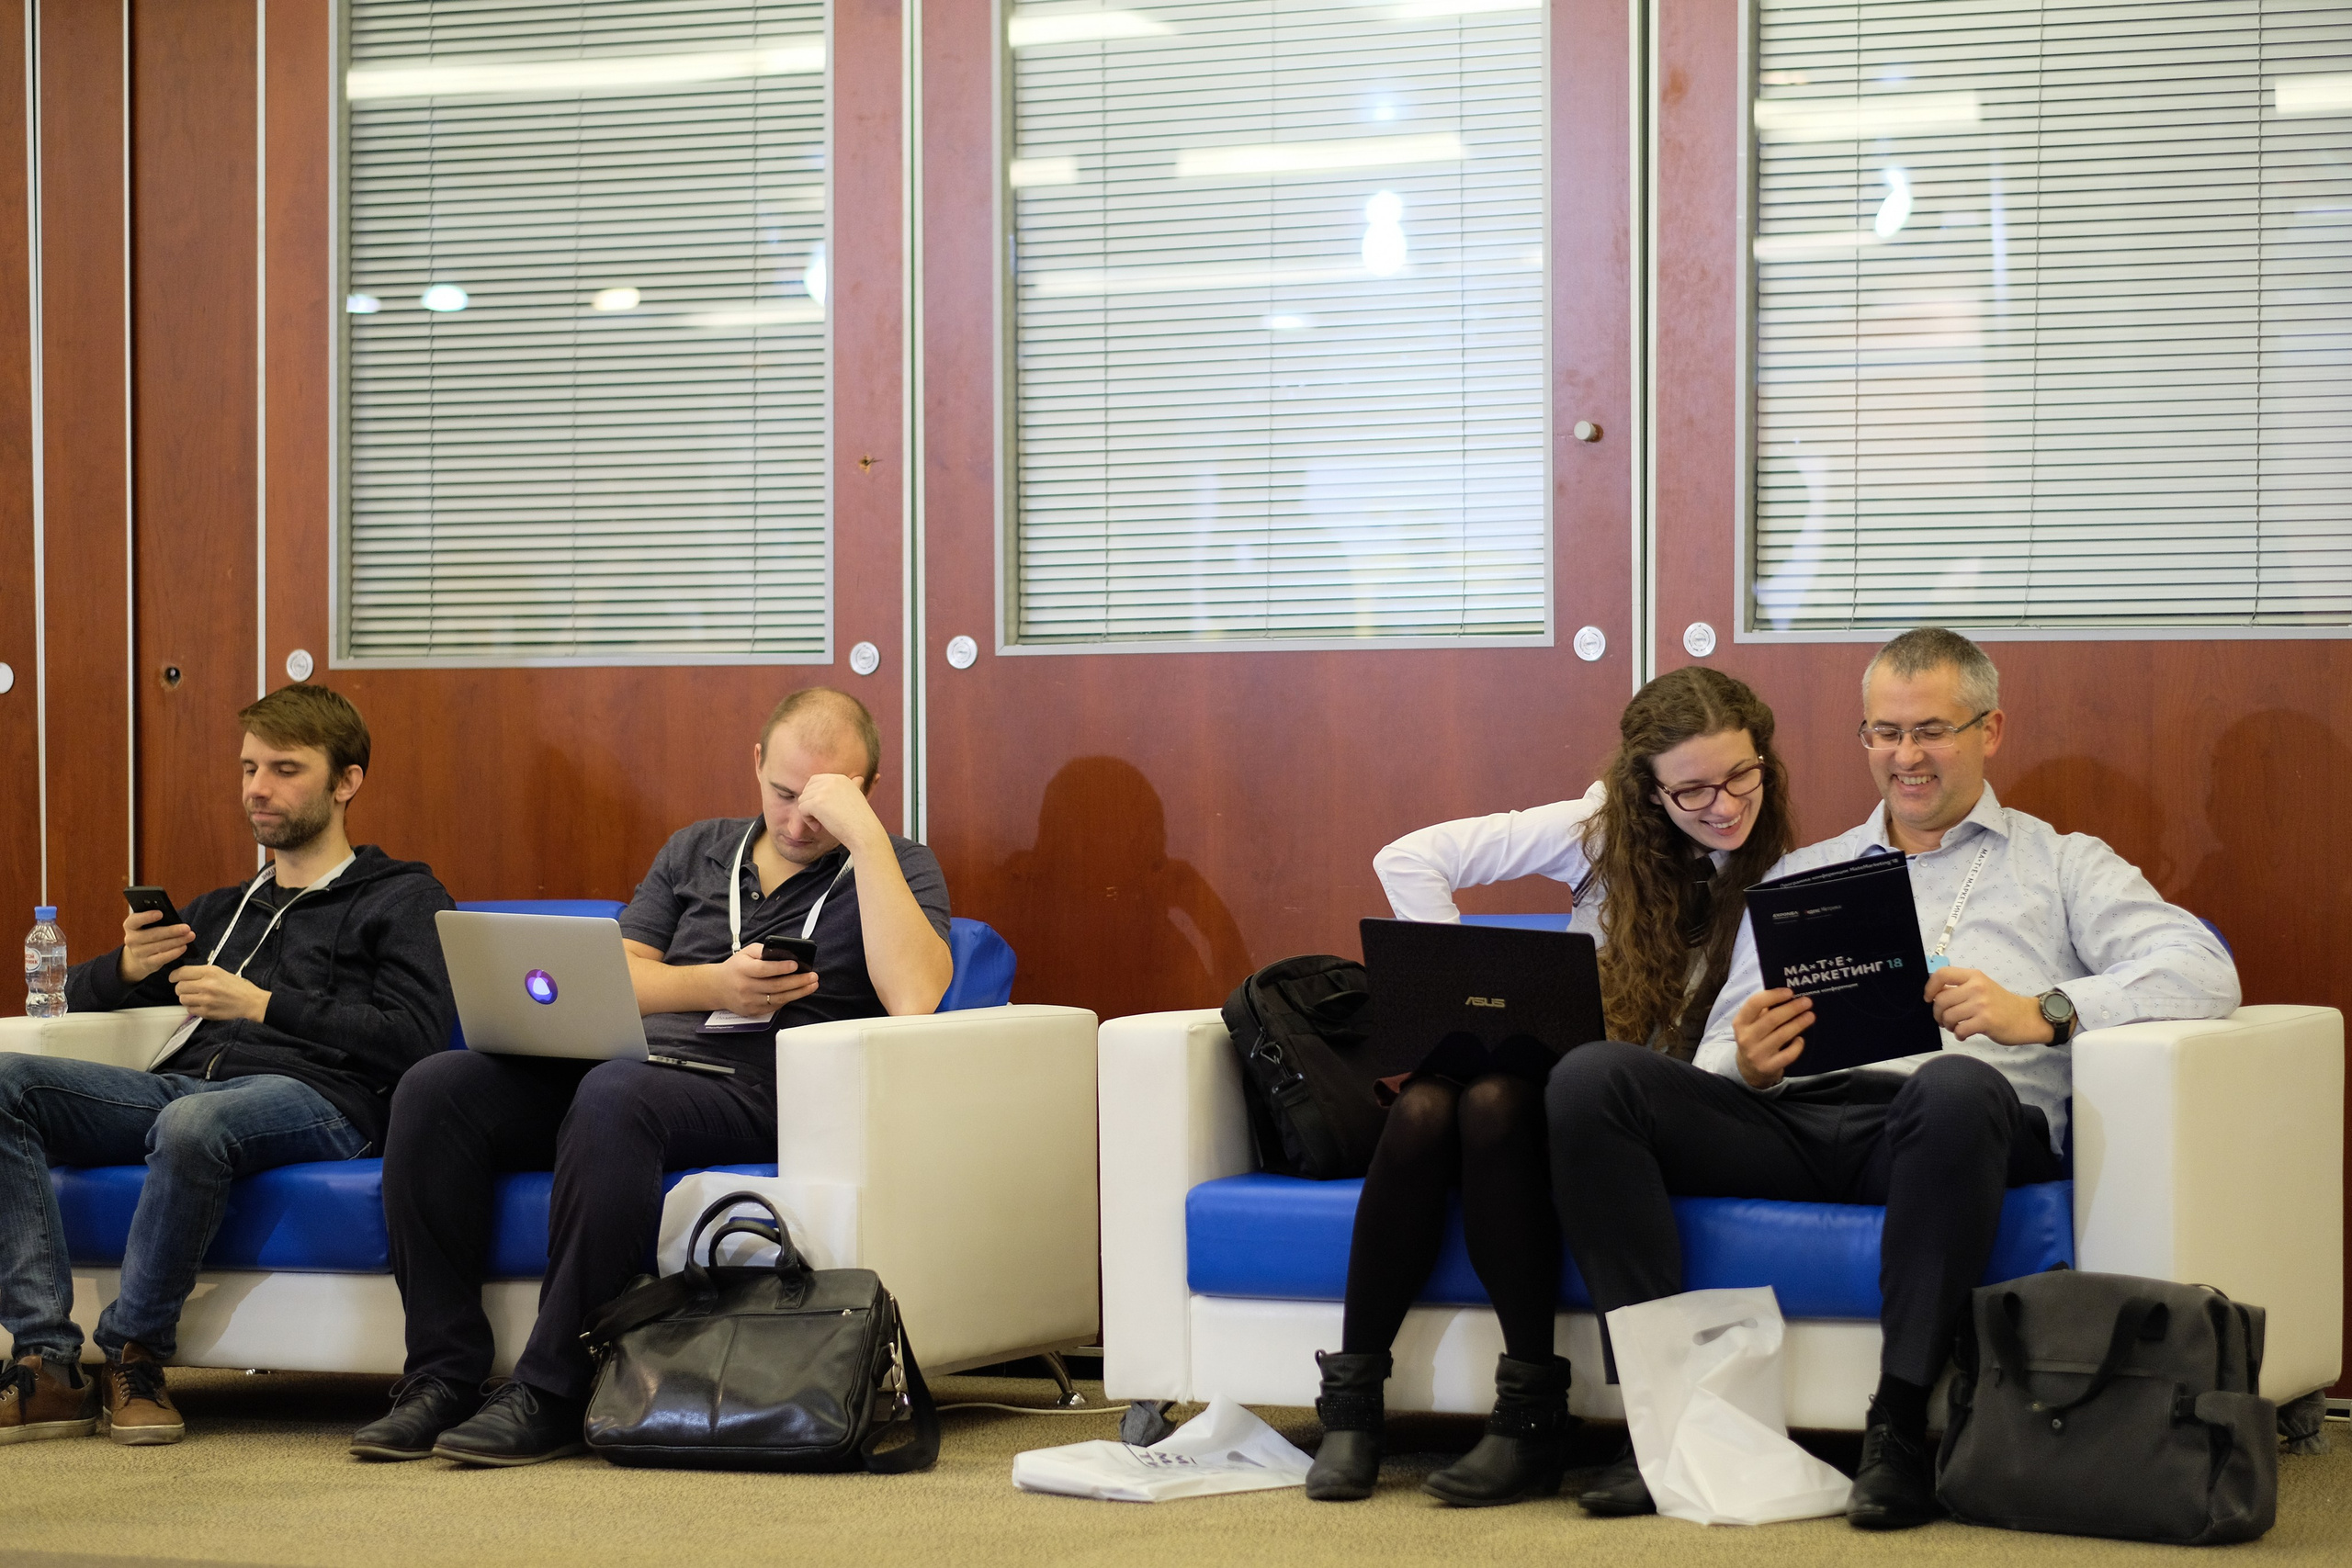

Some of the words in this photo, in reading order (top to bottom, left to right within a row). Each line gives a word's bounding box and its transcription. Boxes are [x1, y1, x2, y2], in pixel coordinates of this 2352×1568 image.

[1951, 877, 1974, 919] МАРКЕТИНГ
[1786, 961, 1883, 987] МАРКЕТИНГ
[1886, 957, 1904, 969] 18
[1465, 997, 1505, 1008] ASUS
